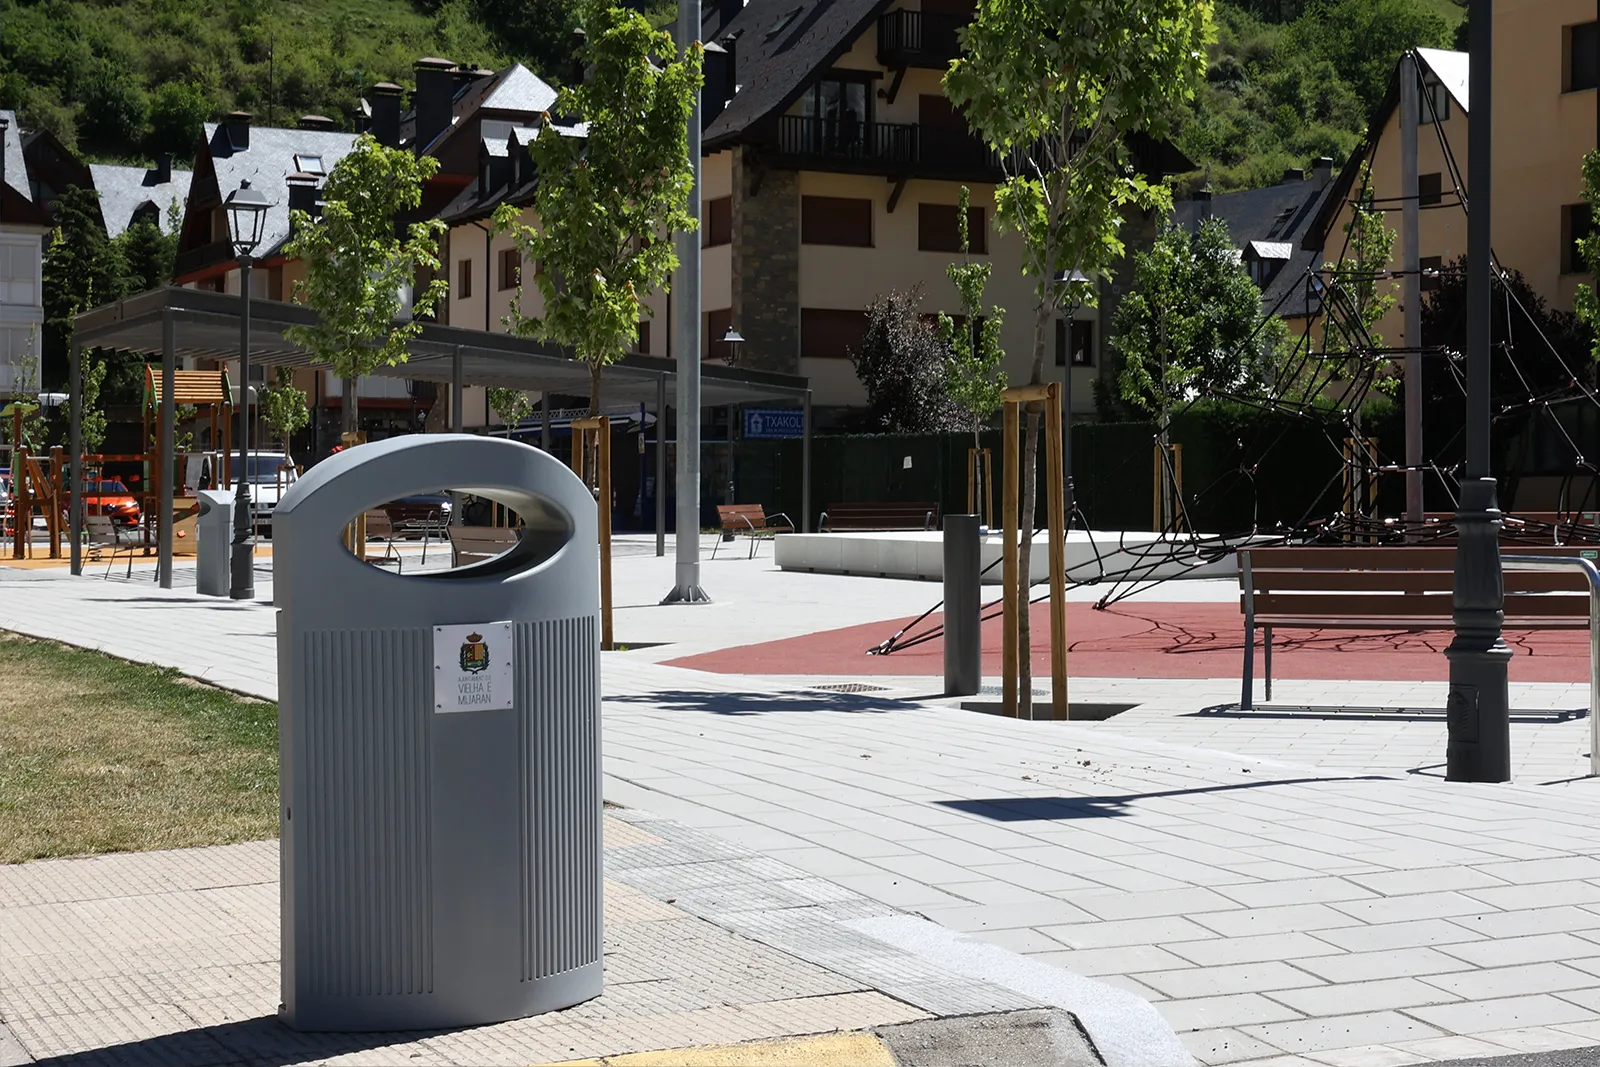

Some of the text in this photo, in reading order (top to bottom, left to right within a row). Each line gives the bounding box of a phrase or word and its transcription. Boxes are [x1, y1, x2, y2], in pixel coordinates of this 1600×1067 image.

[458, 682, 492, 694] VIELHA E
[458, 694, 492, 705] MIJARAN
